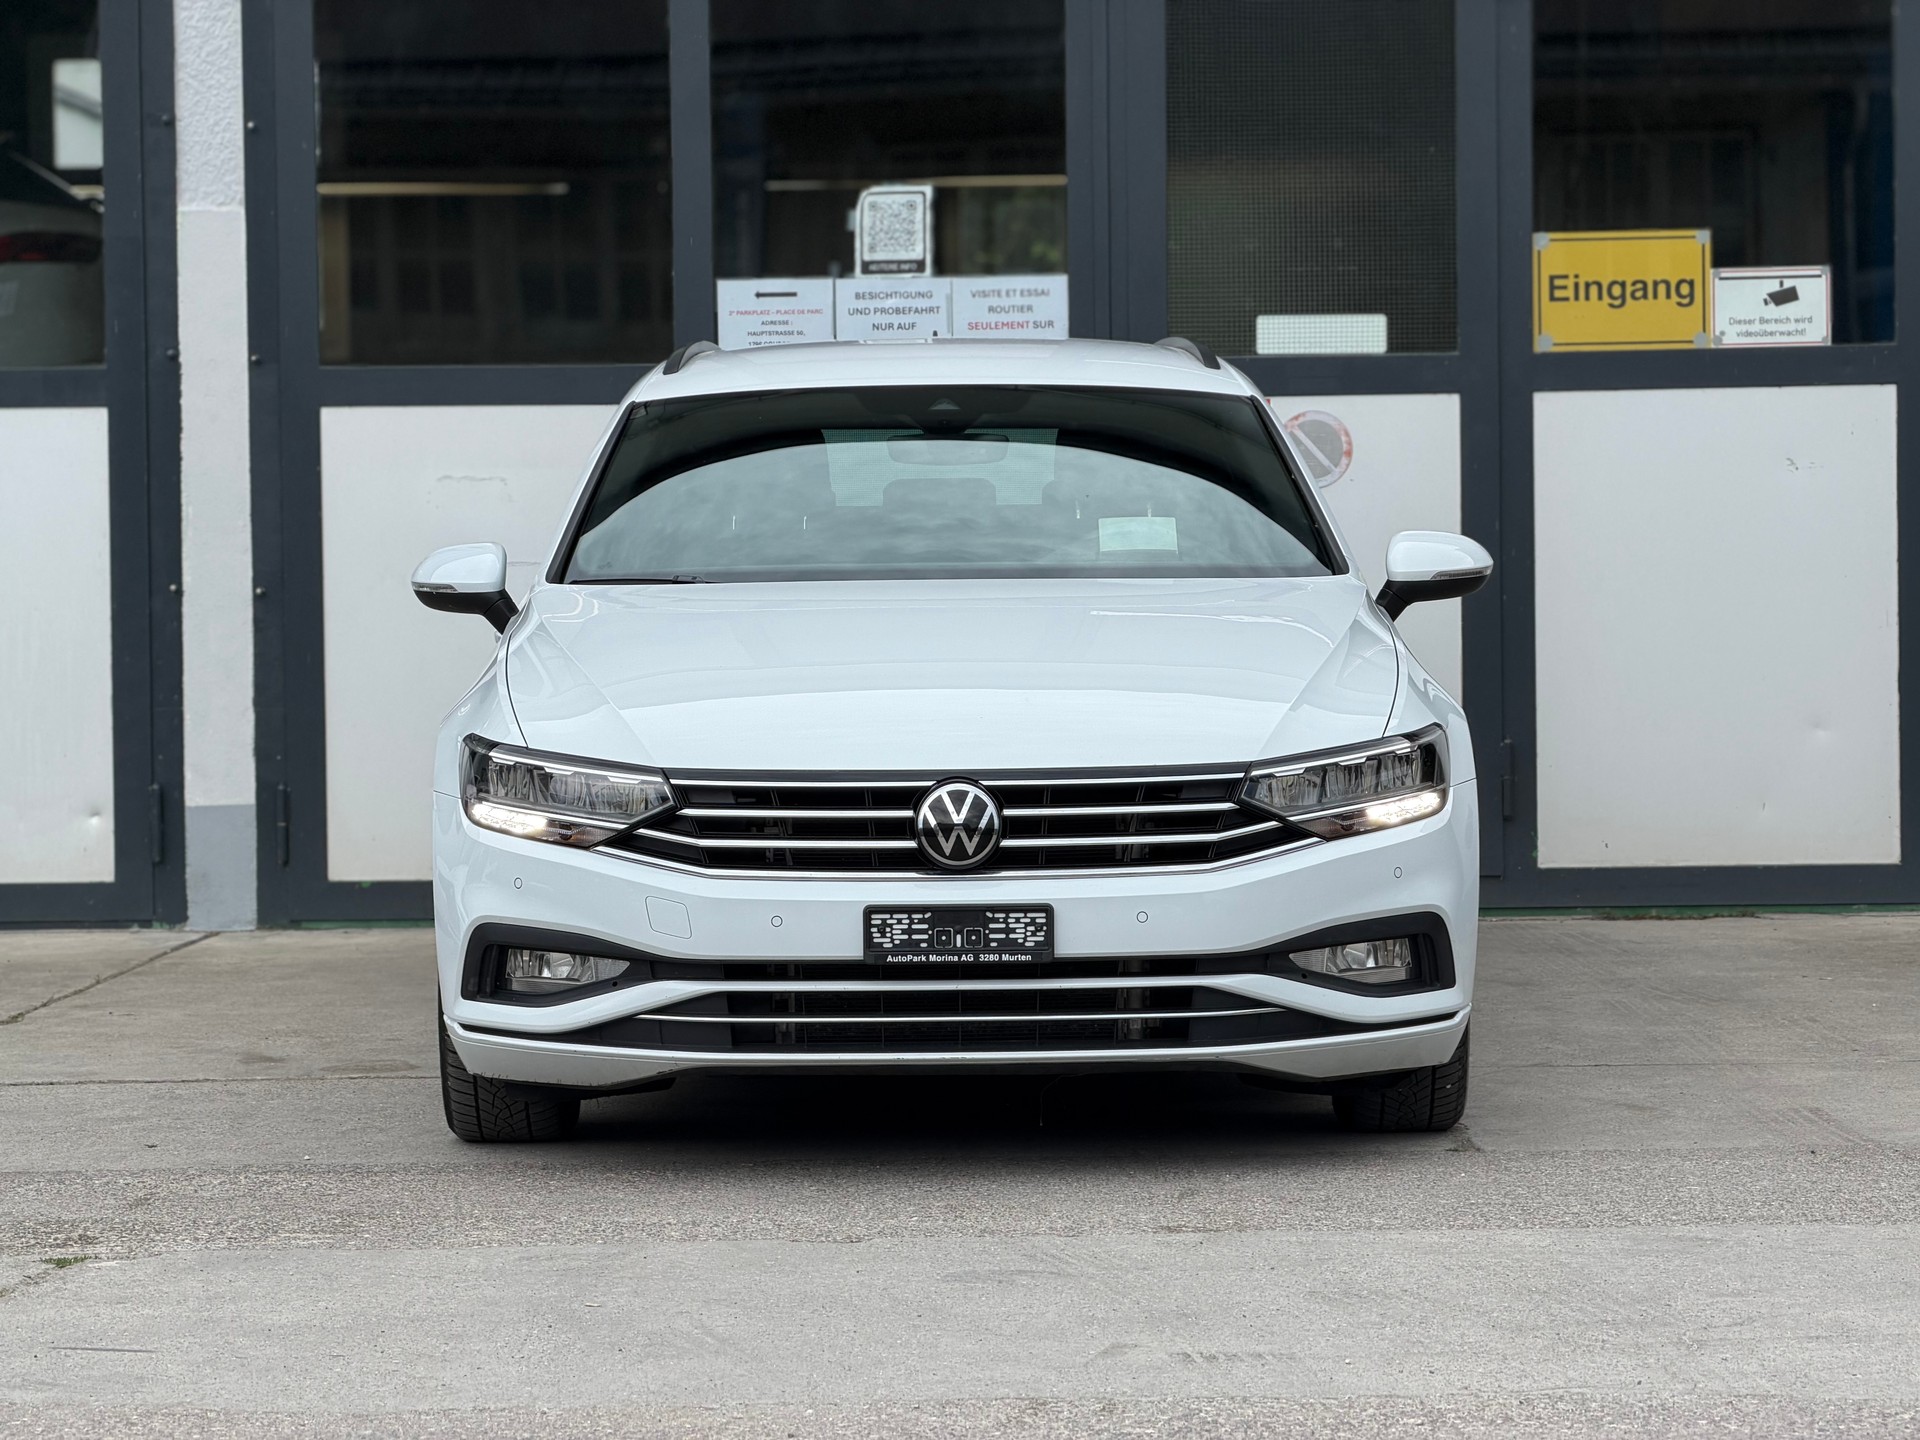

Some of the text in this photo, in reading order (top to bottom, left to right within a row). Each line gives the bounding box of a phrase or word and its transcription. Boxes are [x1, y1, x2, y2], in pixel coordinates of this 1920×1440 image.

[854, 291, 934, 300] BESICHTIGUNG
[970, 288, 1050, 298] VISITE ET ESSAI
[1548, 274, 1696, 309] Eingang
[847, 306, 941, 316] UND PROBEFAHRT
[987, 304, 1034, 314] ROUTIER
[967, 320, 1055, 330] SEULEMENT SUR
[1728, 315, 1813, 326] Dieser Bereich wird
[872, 322, 917, 331] NUR AUF
[1735, 327, 1807, 338] videoüberwacht!
[920, 785, 996, 862] VW
[886, 954, 1032, 962] AutoPark Morina AG 3280 Murten
